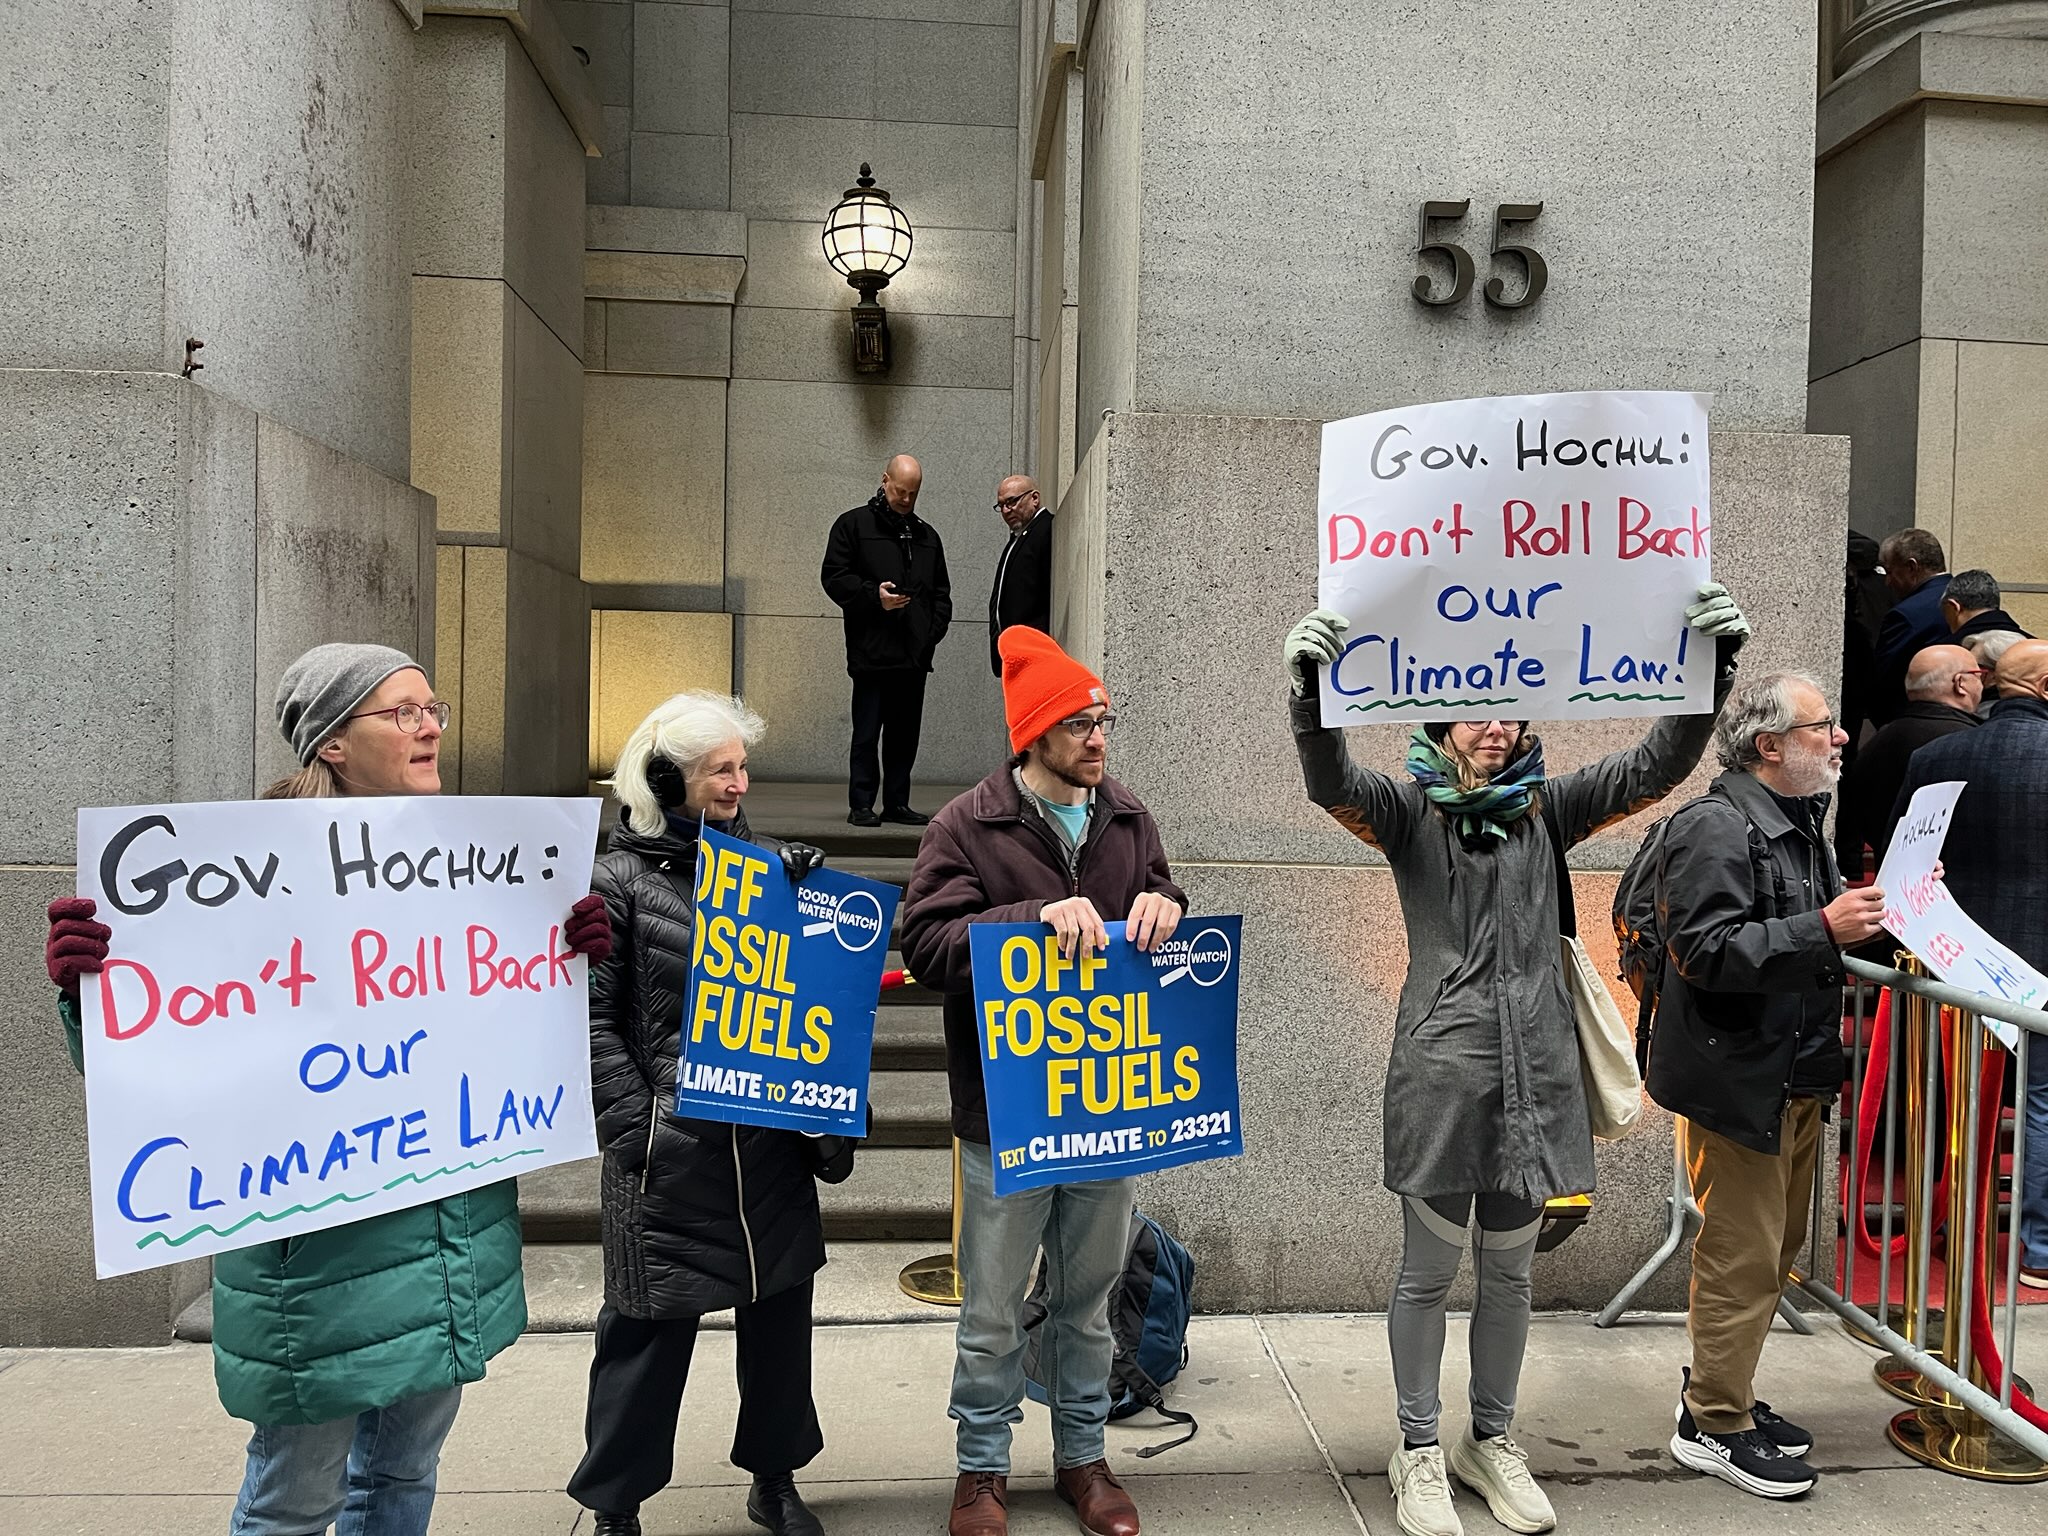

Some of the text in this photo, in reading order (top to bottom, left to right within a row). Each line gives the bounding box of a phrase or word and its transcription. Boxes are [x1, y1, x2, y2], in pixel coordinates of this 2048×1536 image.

[1411, 197, 1549, 308] 55
[1328, 496, 1710, 564] Don't Roll Back
[1437, 583, 1562, 622] our
[1331, 624, 1688, 696] Climate Law!
[797, 900, 878, 931] WATER WATCH
[1156, 940, 1190, 954] OOD&
[101, 925, 577, 1040] Don't Roll Back
[1151, 950, 1228, 968] WATER WATCH
[691, 981, 833, 1065] FUELS
[984, 991, 1161, 1060] FOSSIL
[299, 1030, 428, 1093] our
[1047, 1045, 1201, 1117] FUELS
[766, 1083, 786, 1103] TO
[789, 1079, 858, 1112] 23321
[117, 1110, 430, 1223] CLIMATE
[999, 1147, 1026, 1169] TEXT
[1028, 1126, 1143, 1162] CLIMATE
[1146, 1129, 1167, 1148] TO
[1170, 1110, 1232, 1143] 23321
[1695, 1431, 1732, 1461] HOKA
